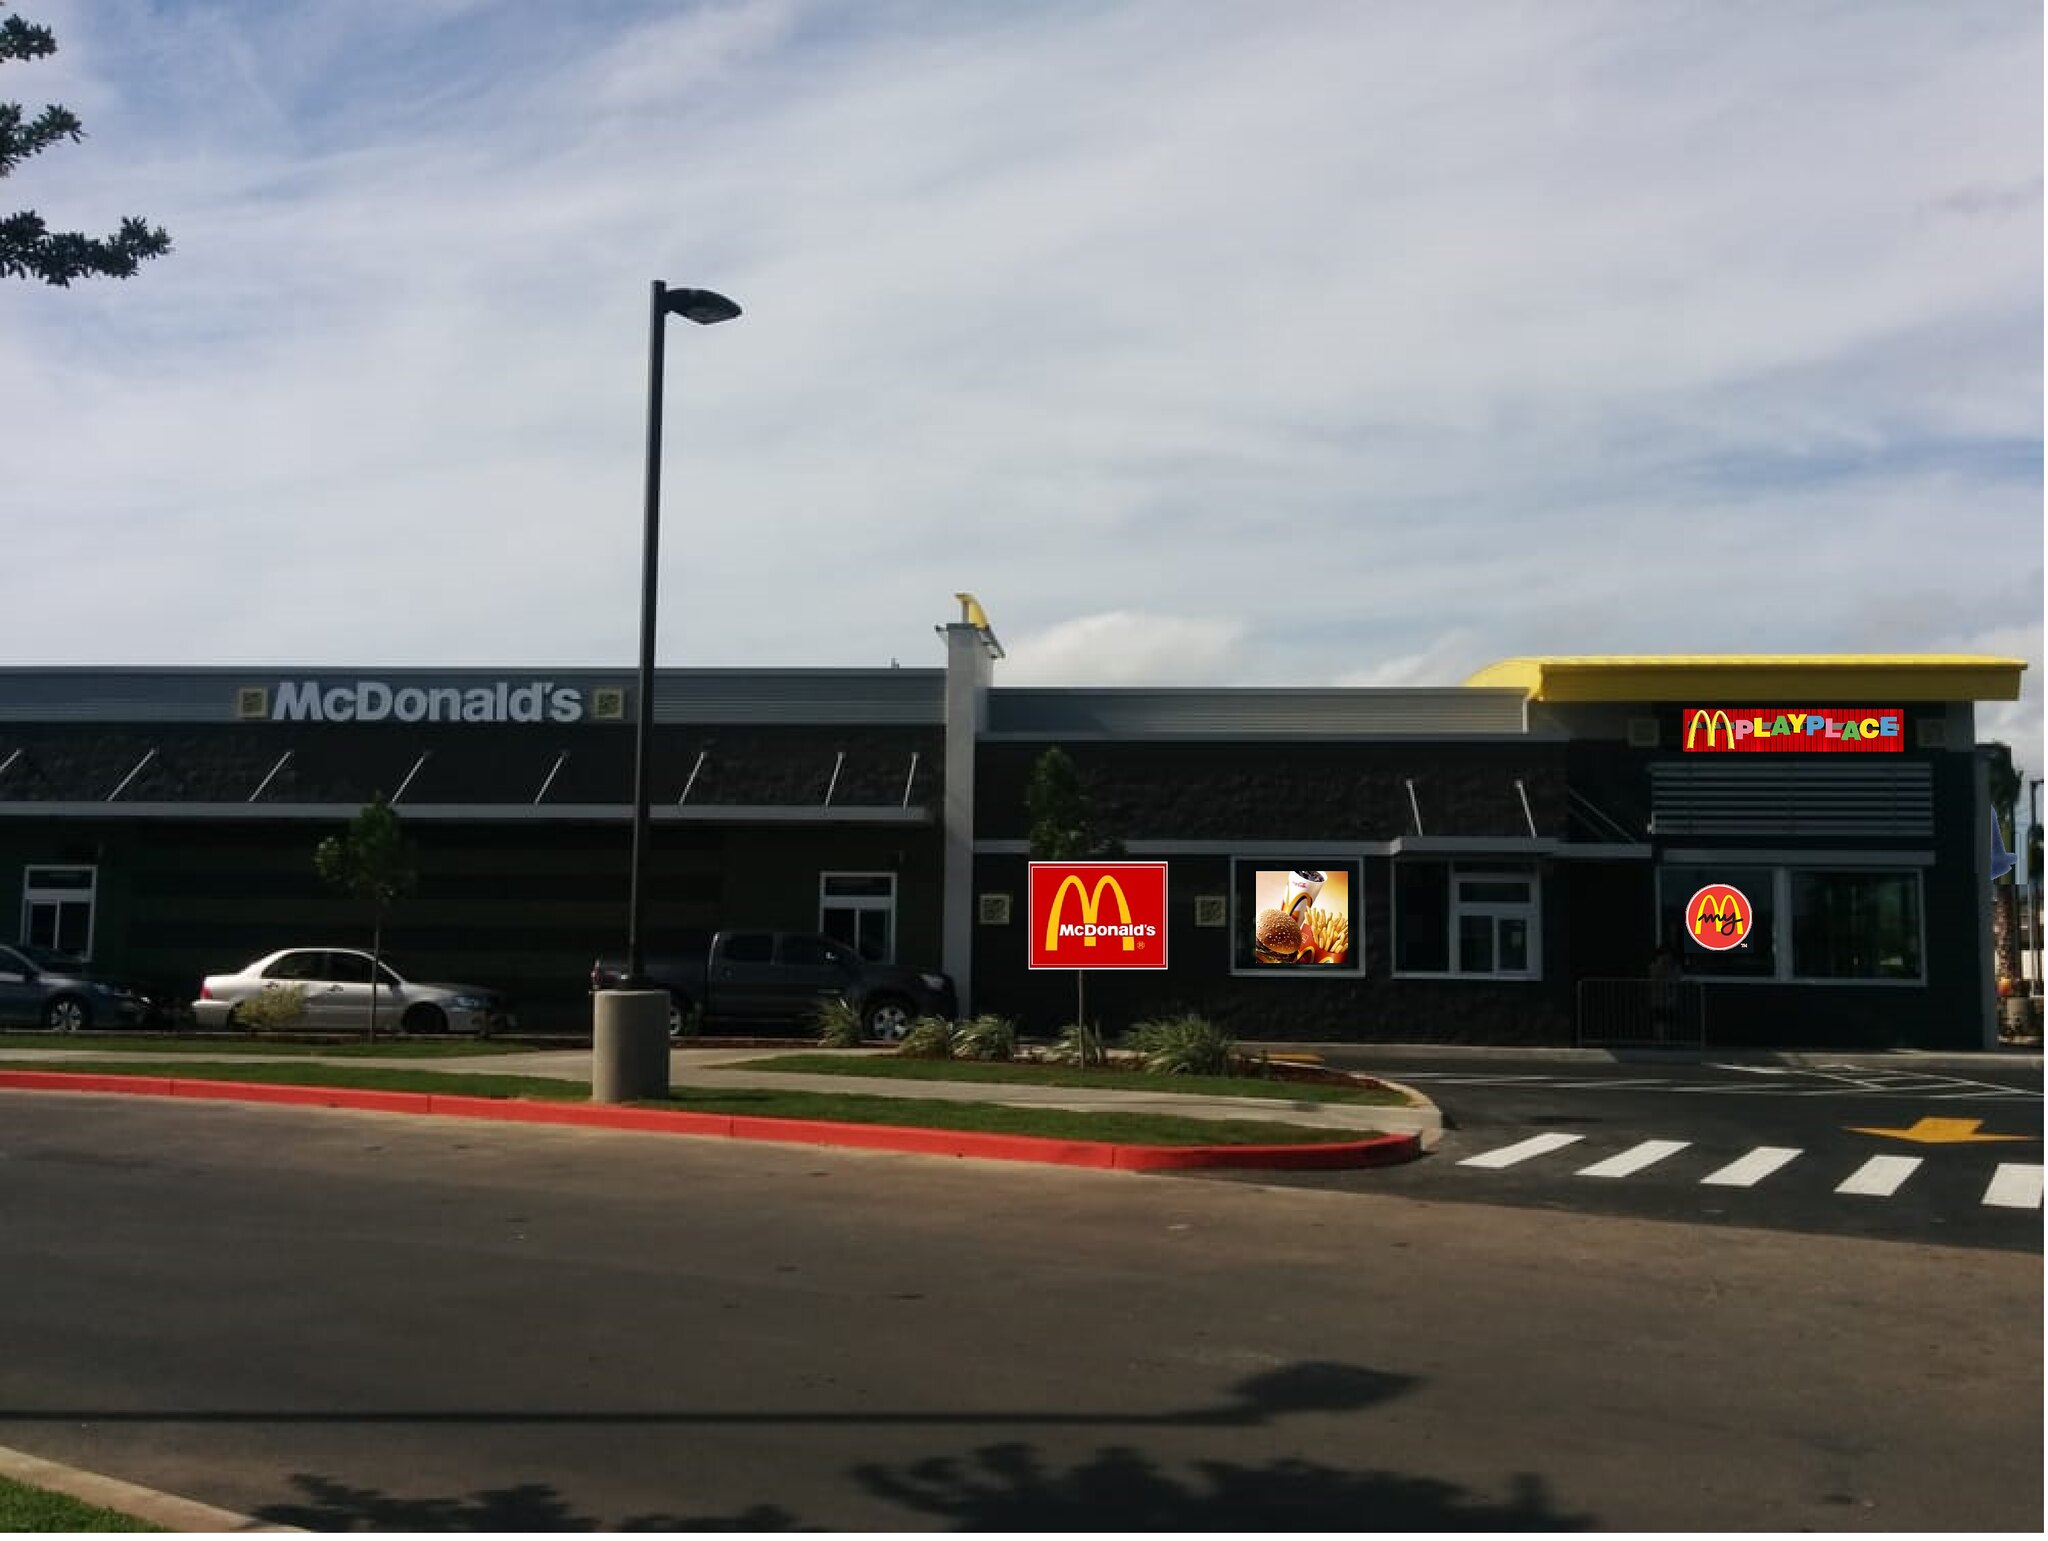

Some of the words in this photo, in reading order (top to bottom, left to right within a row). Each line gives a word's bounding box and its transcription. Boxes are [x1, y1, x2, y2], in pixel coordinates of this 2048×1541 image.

[271, 681, 583, 722] McDonald's
[1735, 713, 1898, 741] PLAYPLACE
[1059, 924, 1156, 937] McDonald's
[1698, 912, 1743, 936] my
